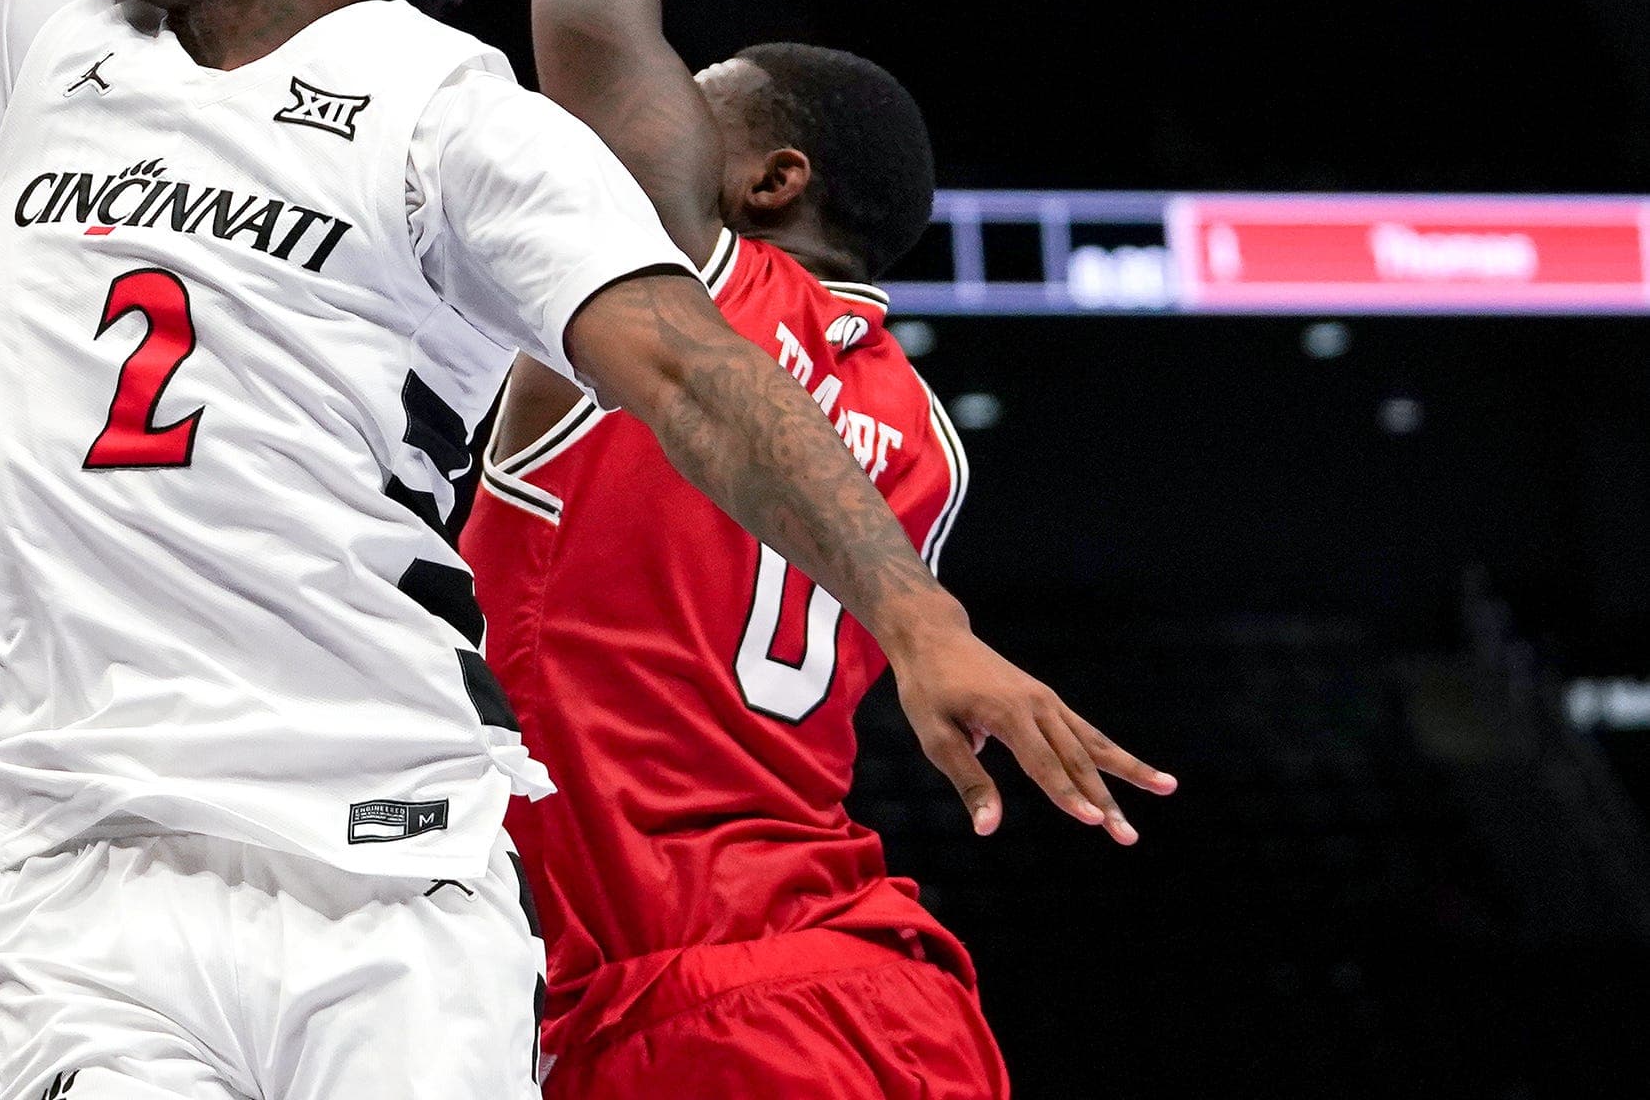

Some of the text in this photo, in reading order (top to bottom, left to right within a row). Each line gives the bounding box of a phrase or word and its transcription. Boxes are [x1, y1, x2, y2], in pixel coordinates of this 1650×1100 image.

[274, 76, 370, 141] XII
[14, 160, 353, 273] CINCINNATI
[81, 267, 206, 469] 2
[418, 812, 435, 827] M
